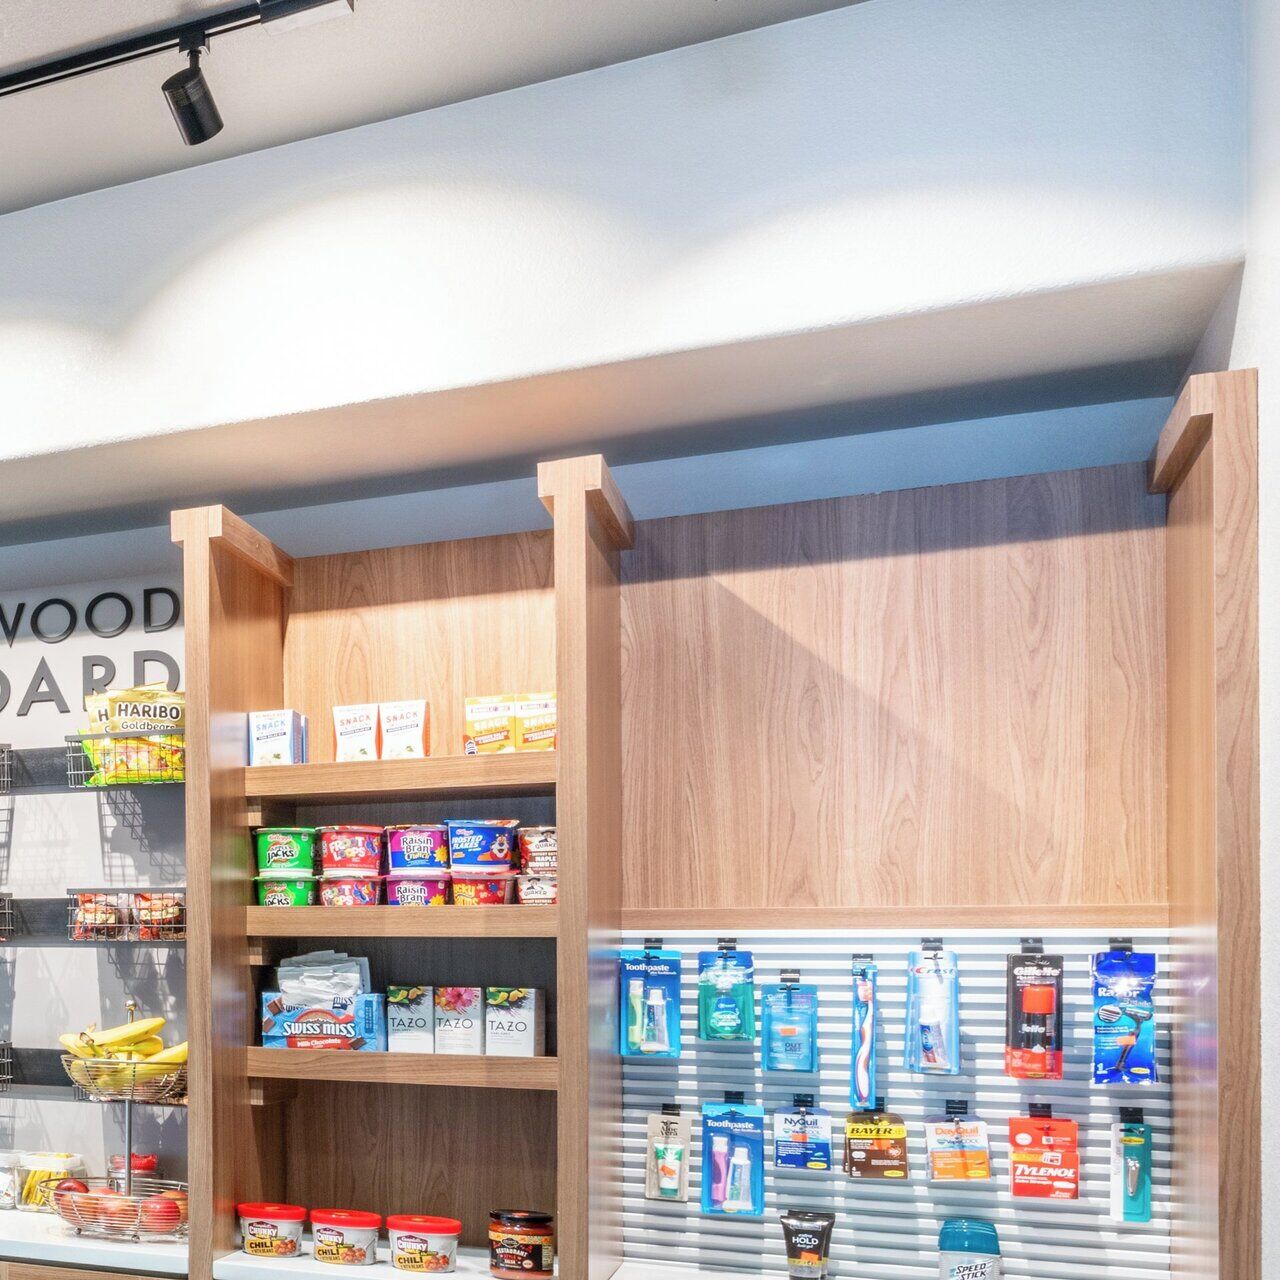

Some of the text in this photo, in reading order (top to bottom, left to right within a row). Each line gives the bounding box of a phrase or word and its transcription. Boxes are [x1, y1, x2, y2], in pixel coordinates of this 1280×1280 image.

[118, 703, 180, 720] HARIBO
[402, 836, 433, 847] Raisin
[452, 835, 483, 844] FROSTED
[405, 844, 430, 853] Bran
[453, 842, 480, 851] FLAKES
[396, 886, 427, 896] Raisin
[400, 894, 424, 903] Bran
[625, 963, 670, 973] Toothpaste
[1013, 967, 1061, 977] Gillette
[390, 1018, 427, 1029] TAZO
[437, 1018, 473, 1029] TAZO
[489, 1021, 527, 1032] TAZO
[706, 1119, 755, 1130] Toothpaste
[784, 1117, 818, 1127] NyQuil
[850, 1127, 893, 1135] BAYER
[934, 1126, 979, 1136] DayQuil
[1013, 1164, 1076, 1178] TYLENOL
[249, 1226, 278, 1237] CHUNKY
[249, 1241, 274, 1249] CHILI
[397, 1240, 428, 1251] CHUNKY
[792, 1236, 819, 1245] HOLD
[397, 1256, 424, 1264] CHILI
[956, 1262, 987, 1274] SPEED
